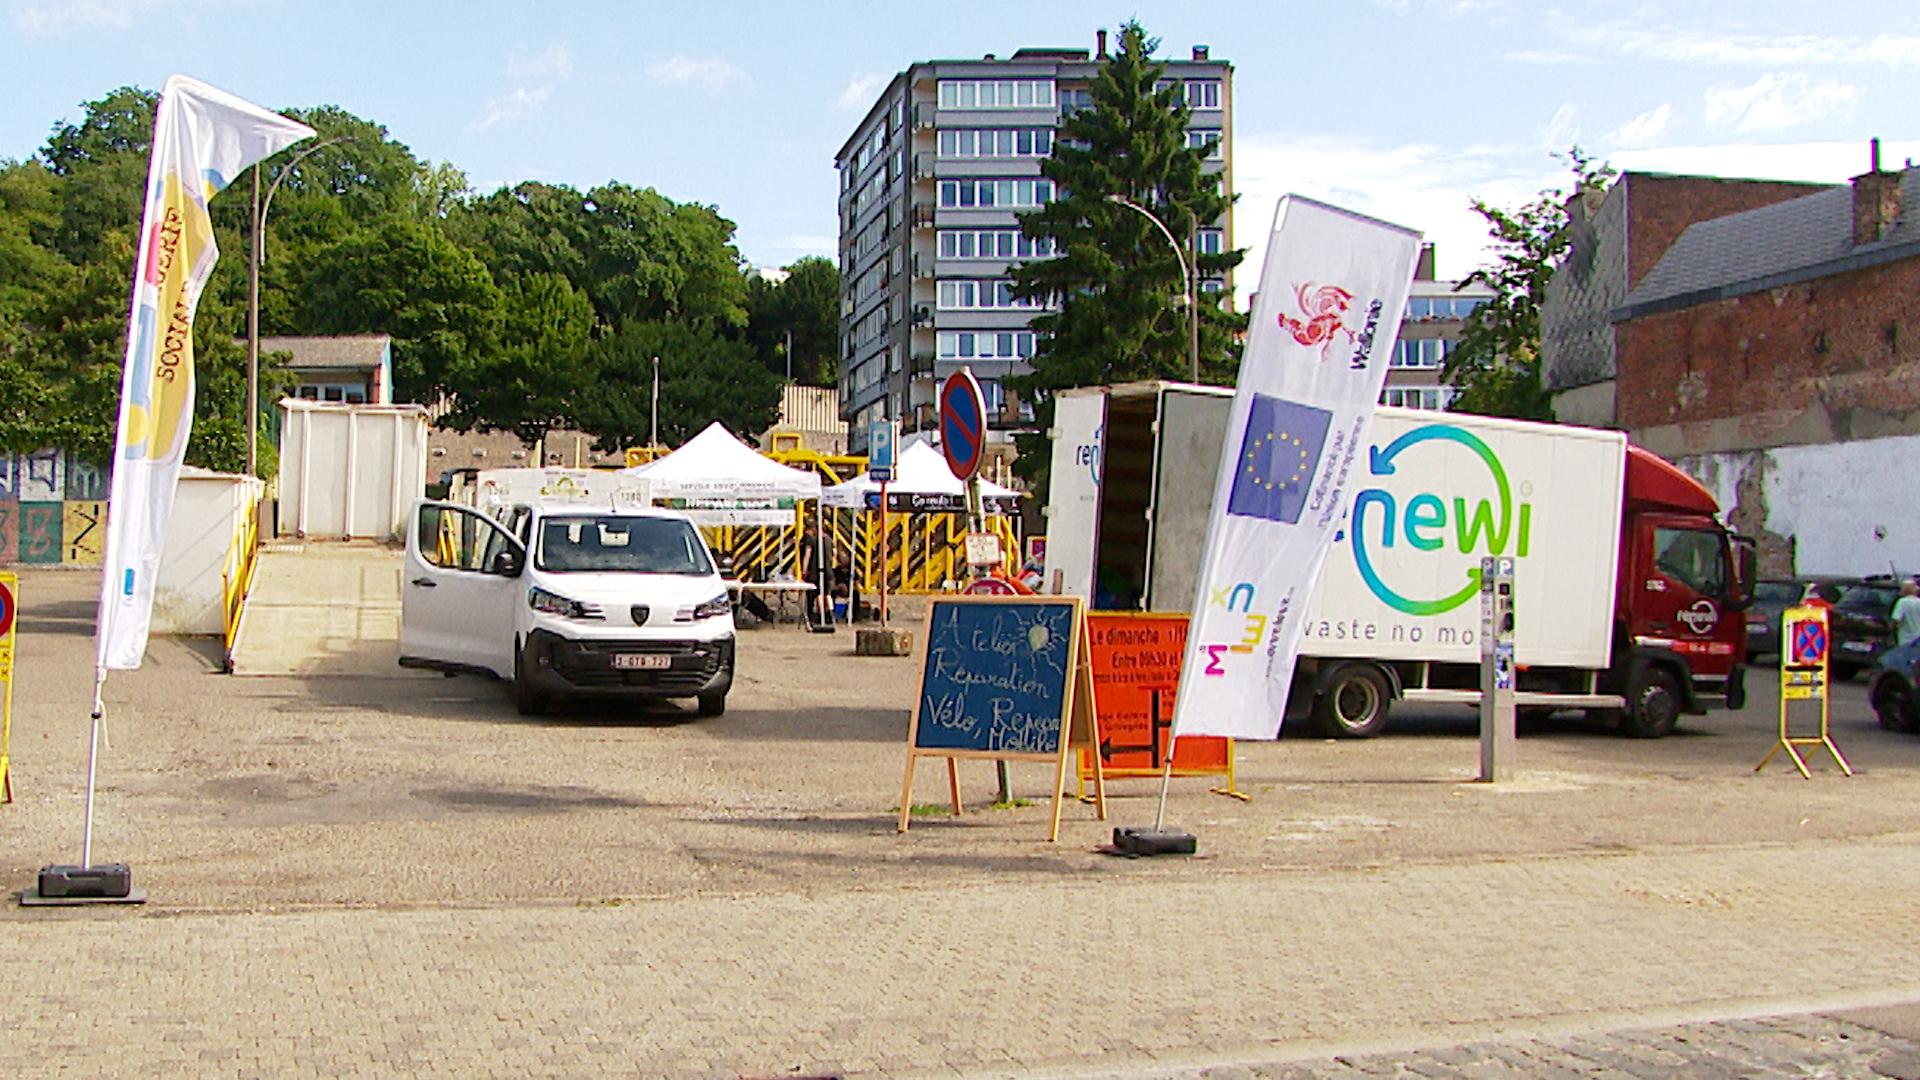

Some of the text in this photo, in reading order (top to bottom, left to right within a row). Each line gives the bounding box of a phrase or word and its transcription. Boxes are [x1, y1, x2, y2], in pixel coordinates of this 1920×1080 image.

[873, 430, 890, 460] P
[1106, 626, 1159, 645] dimanche
[1392, 624, 1422, 642] no
[927, 691, 982, 740] Vélo,
